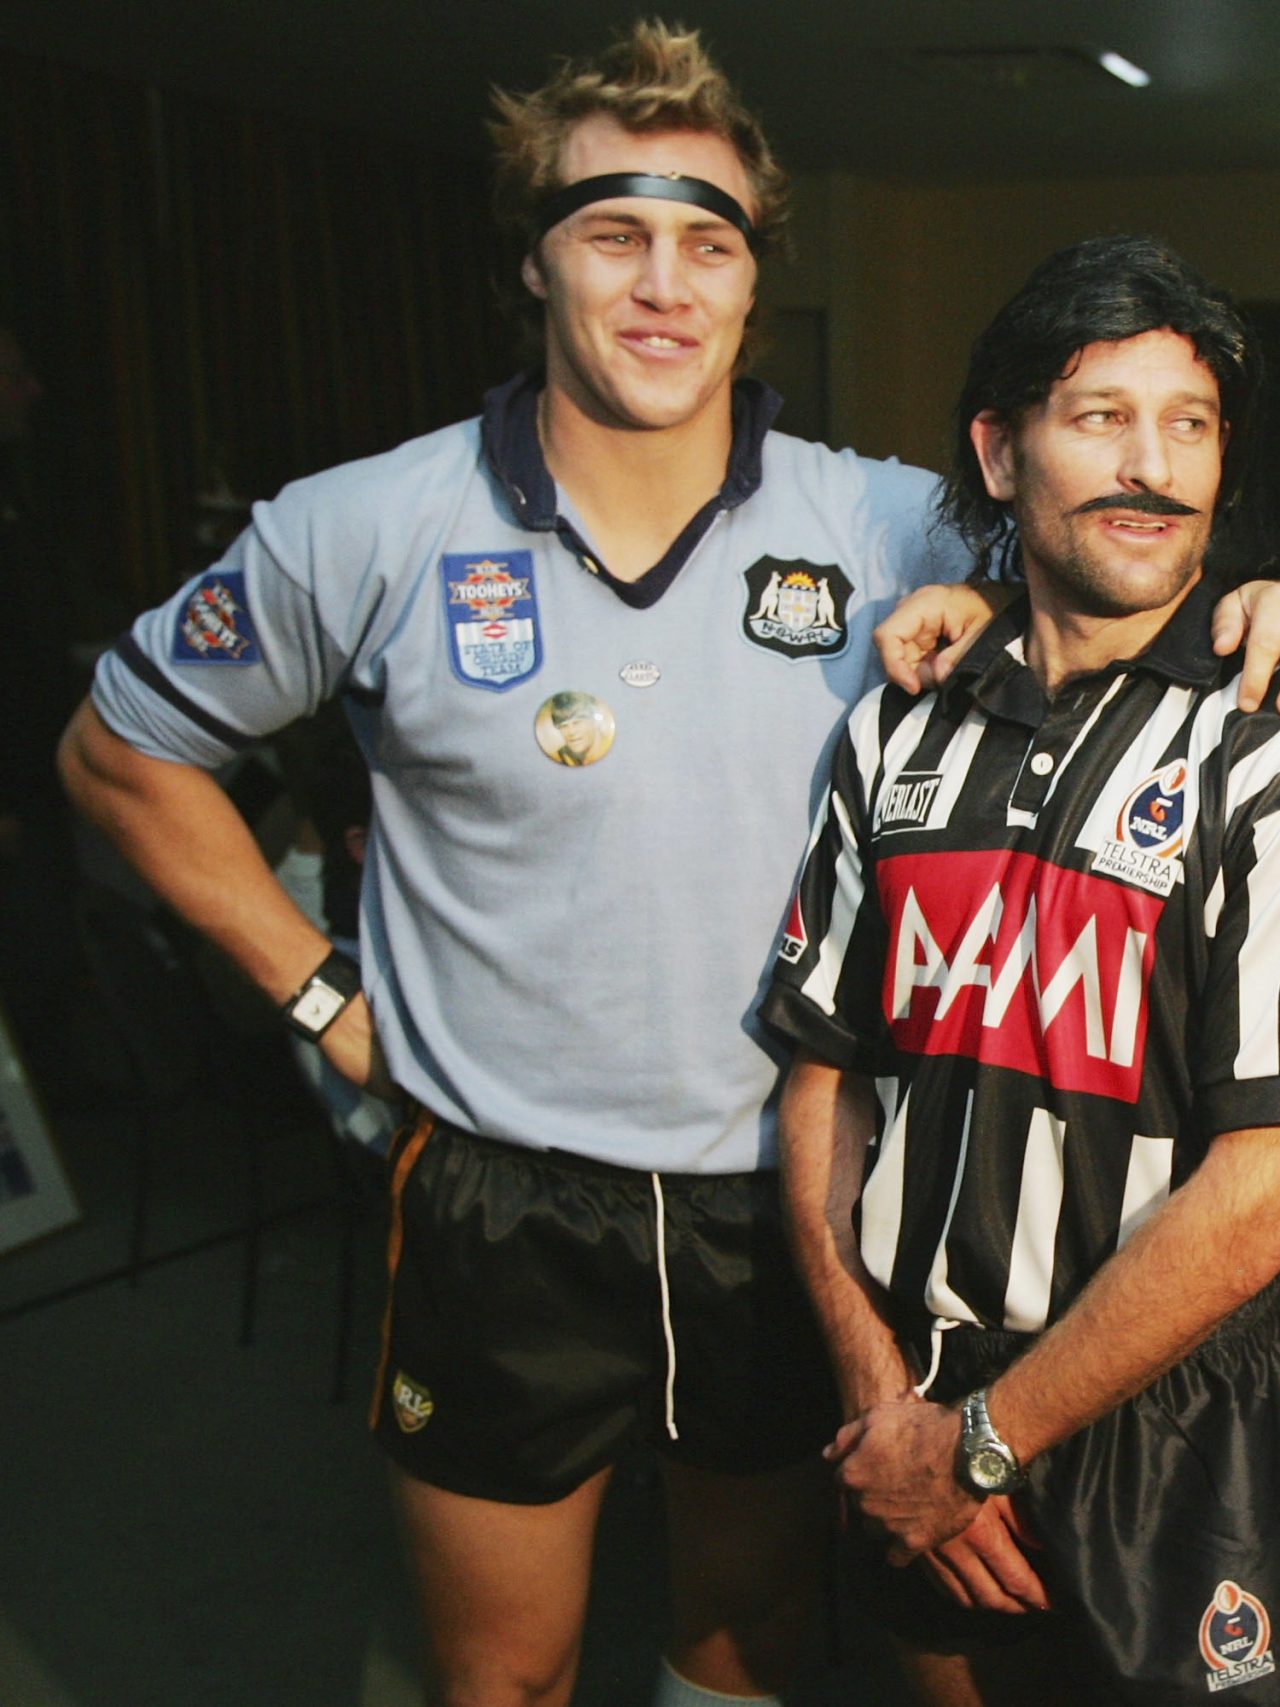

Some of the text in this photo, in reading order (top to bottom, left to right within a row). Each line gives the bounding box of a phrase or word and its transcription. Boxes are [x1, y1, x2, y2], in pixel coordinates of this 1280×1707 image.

[456, 581, 522, 599] TOOHEYS
[876, 777, 941, 824] VERLAST
[1129, 815, 1168, 841] NRL
[1098, 857, 1168, 889] PREMIERSHIP
[1102, 841, 1171, 880] TELSTRA
[892, 881, 1148, 1068] AAMI
[1210, 1653, 1274, 1683] TELSTRA
